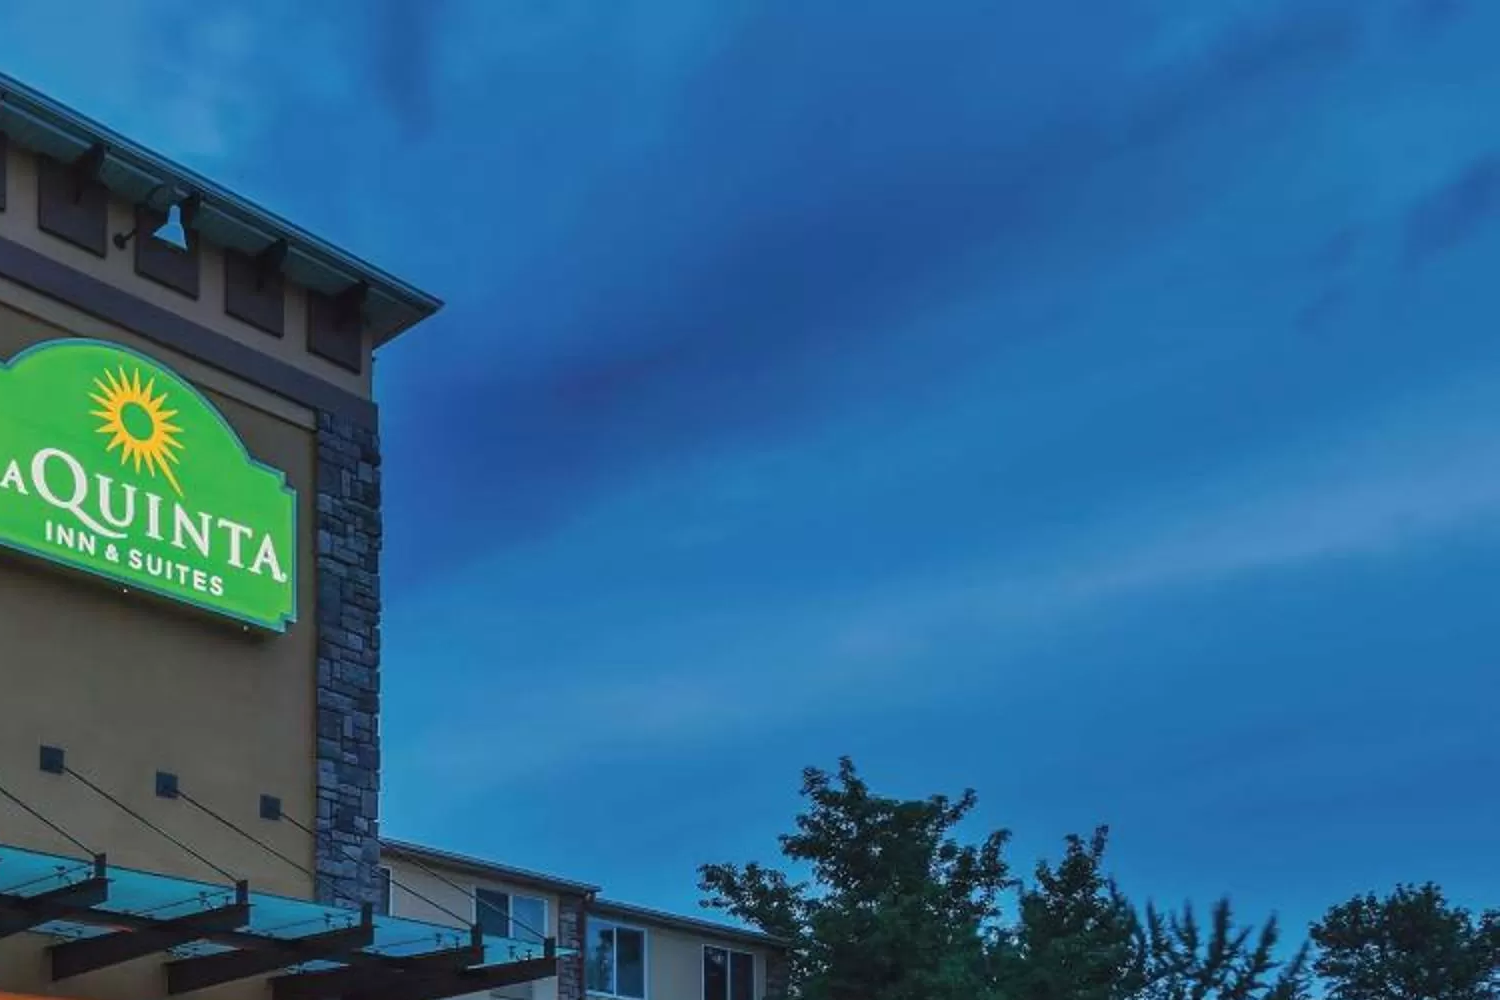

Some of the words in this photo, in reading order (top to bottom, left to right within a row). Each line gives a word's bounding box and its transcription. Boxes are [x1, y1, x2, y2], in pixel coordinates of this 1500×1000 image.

[31, 447, 287, 583] QUINTA
[45, 521, 96, 556] INN
[104, 544, 120, 563] &
[128, 549, 224, 597] SUITES
